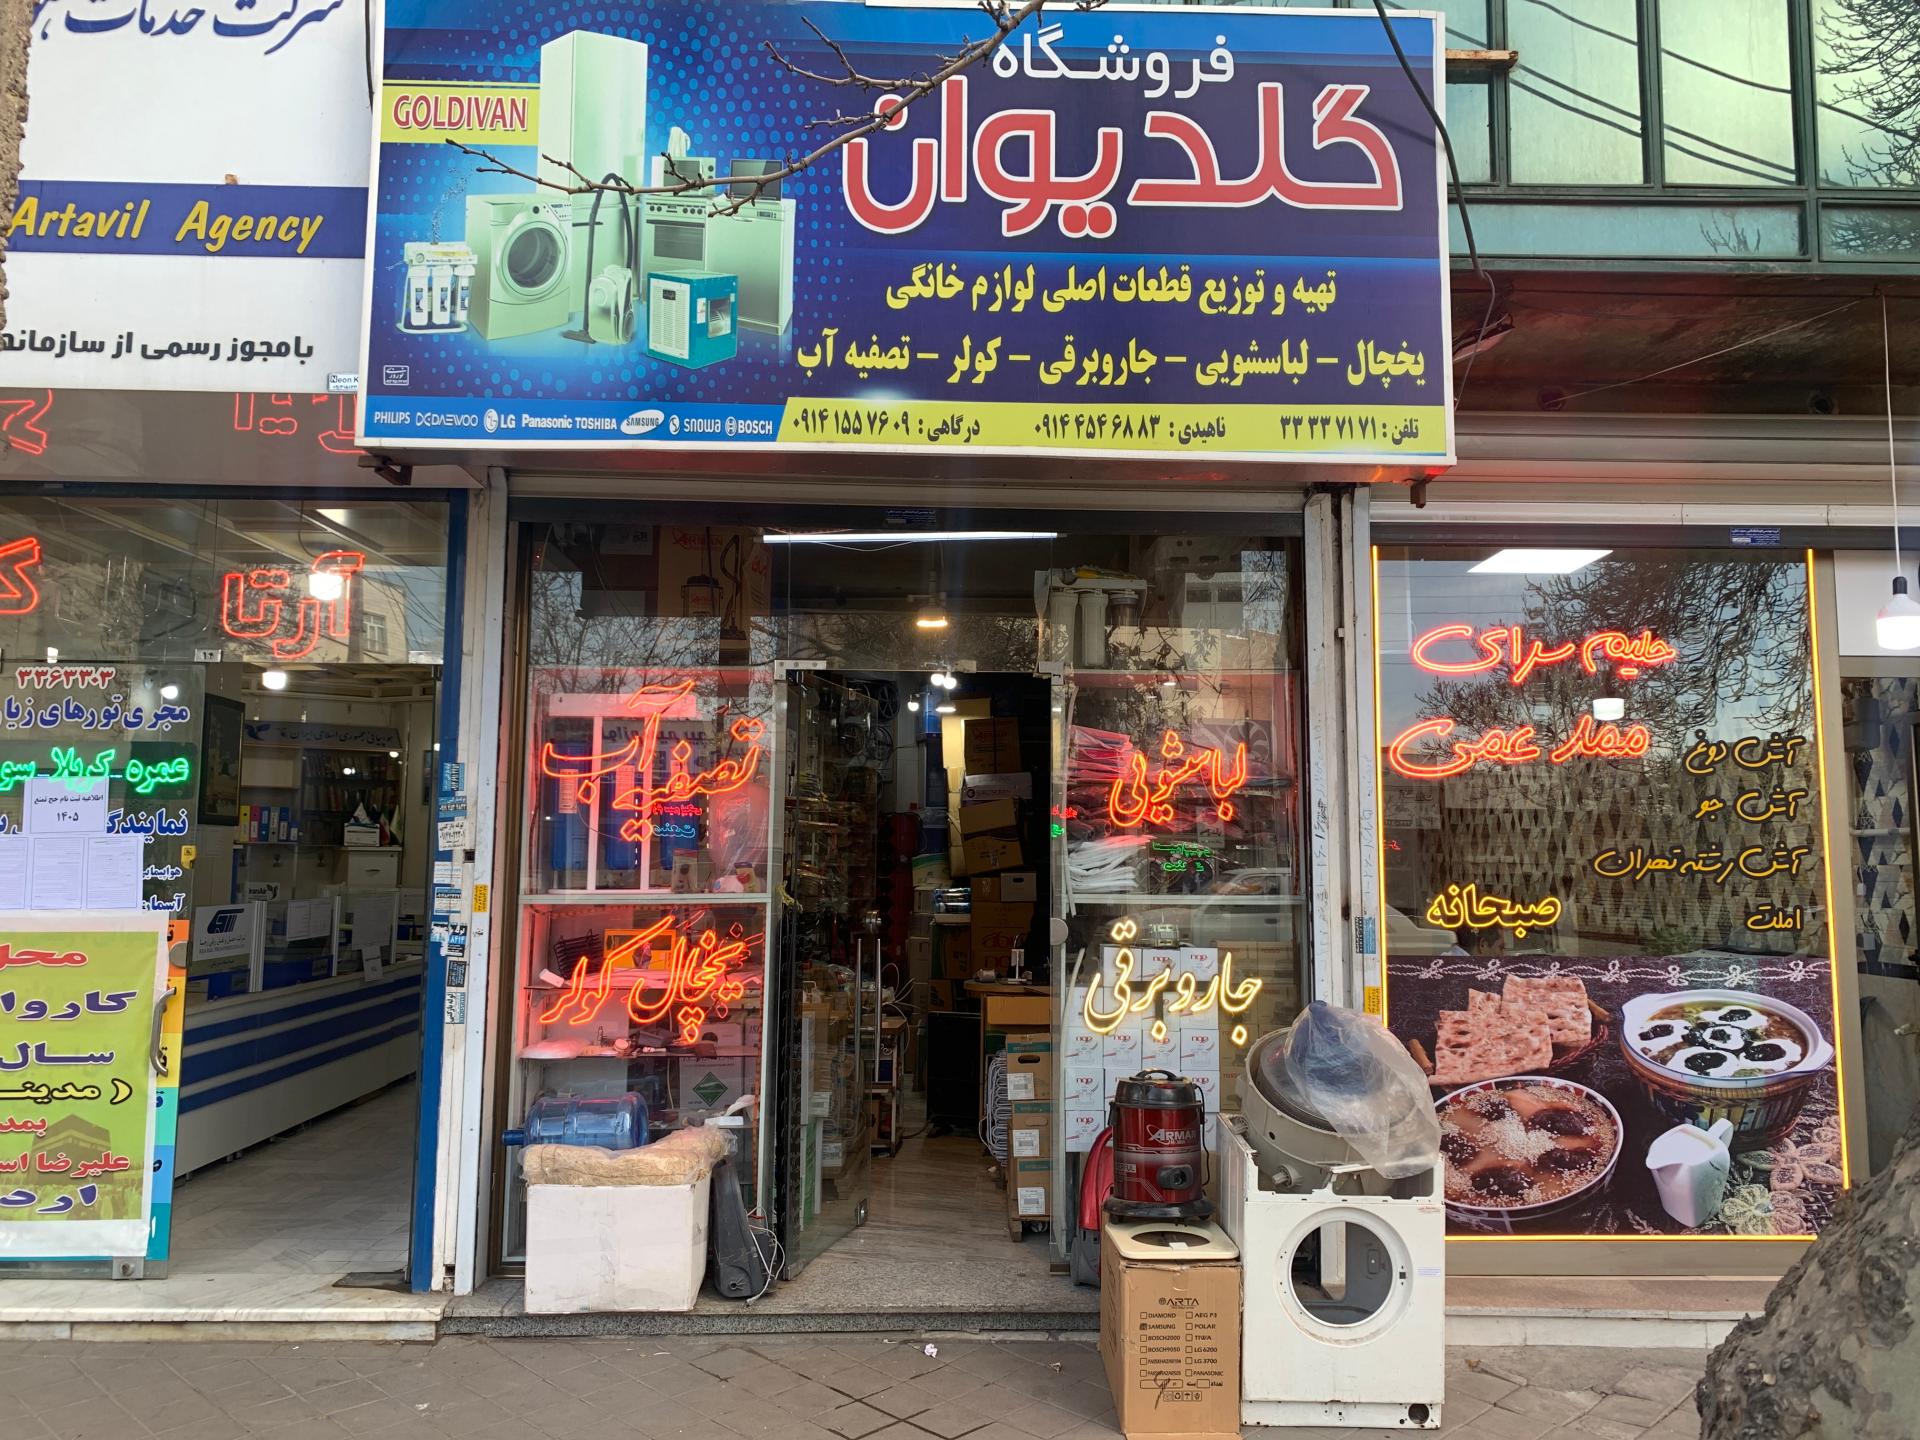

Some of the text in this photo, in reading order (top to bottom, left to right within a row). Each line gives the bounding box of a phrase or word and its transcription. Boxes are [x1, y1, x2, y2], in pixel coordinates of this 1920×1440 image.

[992, 22, 1236, 99] فروشگاه
[393, 94, 527, 131] GOLDIVAN
[842, 75, 1403, 237] گلدیوان
[7, 195, 325, 254] Artavil Agency
[886, 263, 1337, 314] تهیه و توزیع قطعات اصلی لوازم خانگی
[112, 332, 133, 359] از
[141, 340, 221, 360] رسمی
[797, 328, 1426, 390] یخچال لباسشویی جاروبرقی کولر تصفیه آب
[374, 412, 410, 424] PHILIPS
[431, 414, 478, 427] DAEWOO
[500, 415, 516, 428] LG
[522, 414, 572, 429] Panasonic
[575, 417, 617, 430] TOSHIBA
[625, 416, 660, 429] SAMSUNG
[738, 420, 773, 435] BOSCH
[221, 550, 366, 660] آرتا
[1412, 624, 1677, 684] حلیم سرای
[0, 694, 191, 732] مجری تورهای زیا
[543, 678, 695, 804] آب
[1685, 731, 1806, 774] آش دوغ
[51, 747, 117, 794] کربلا
[126, 757, 191, 793] عمره
[48, 796, 58, 804] حج
[57, 811, 79, 822] ۱۴۰۵
[60, 795, 69, 804] نام
[1694, 787, 1806, 821] آش جو
[1593, 842, 1809, 884] آش رشته تهران
[1426, 883, 1562, 938] صبحانه
[1746, 905, 1801, 930] املت
[539, 914, 676, 1025] کولر
[1083, 919, 1263, 1046] جاروبرقی
[0, 1041, 115, 1072] سال
[36, 1151, 131, 1178] علیرضا
[1166, 1297, 1200, 1307] ARTA
